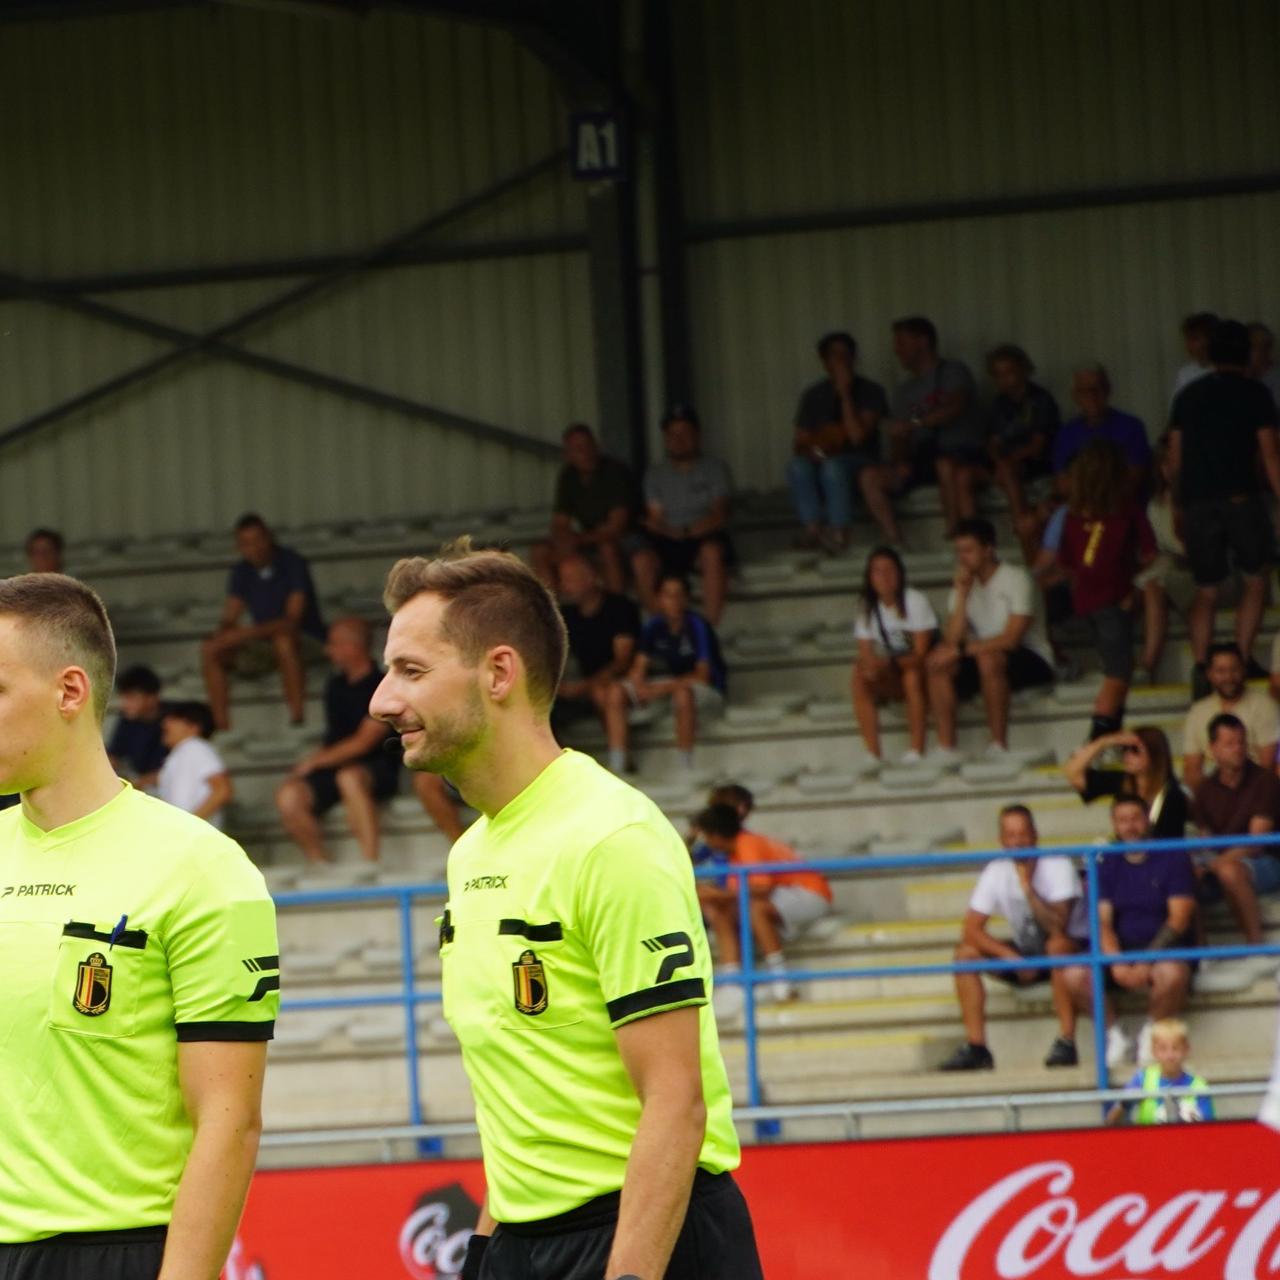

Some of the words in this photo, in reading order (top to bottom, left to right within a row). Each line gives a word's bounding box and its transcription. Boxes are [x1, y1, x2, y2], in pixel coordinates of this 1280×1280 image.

[578, 122, 617, 170] A1
[471, 875, 509, 889] PATRICK
[17, 884, 76, 897] PATRICK
